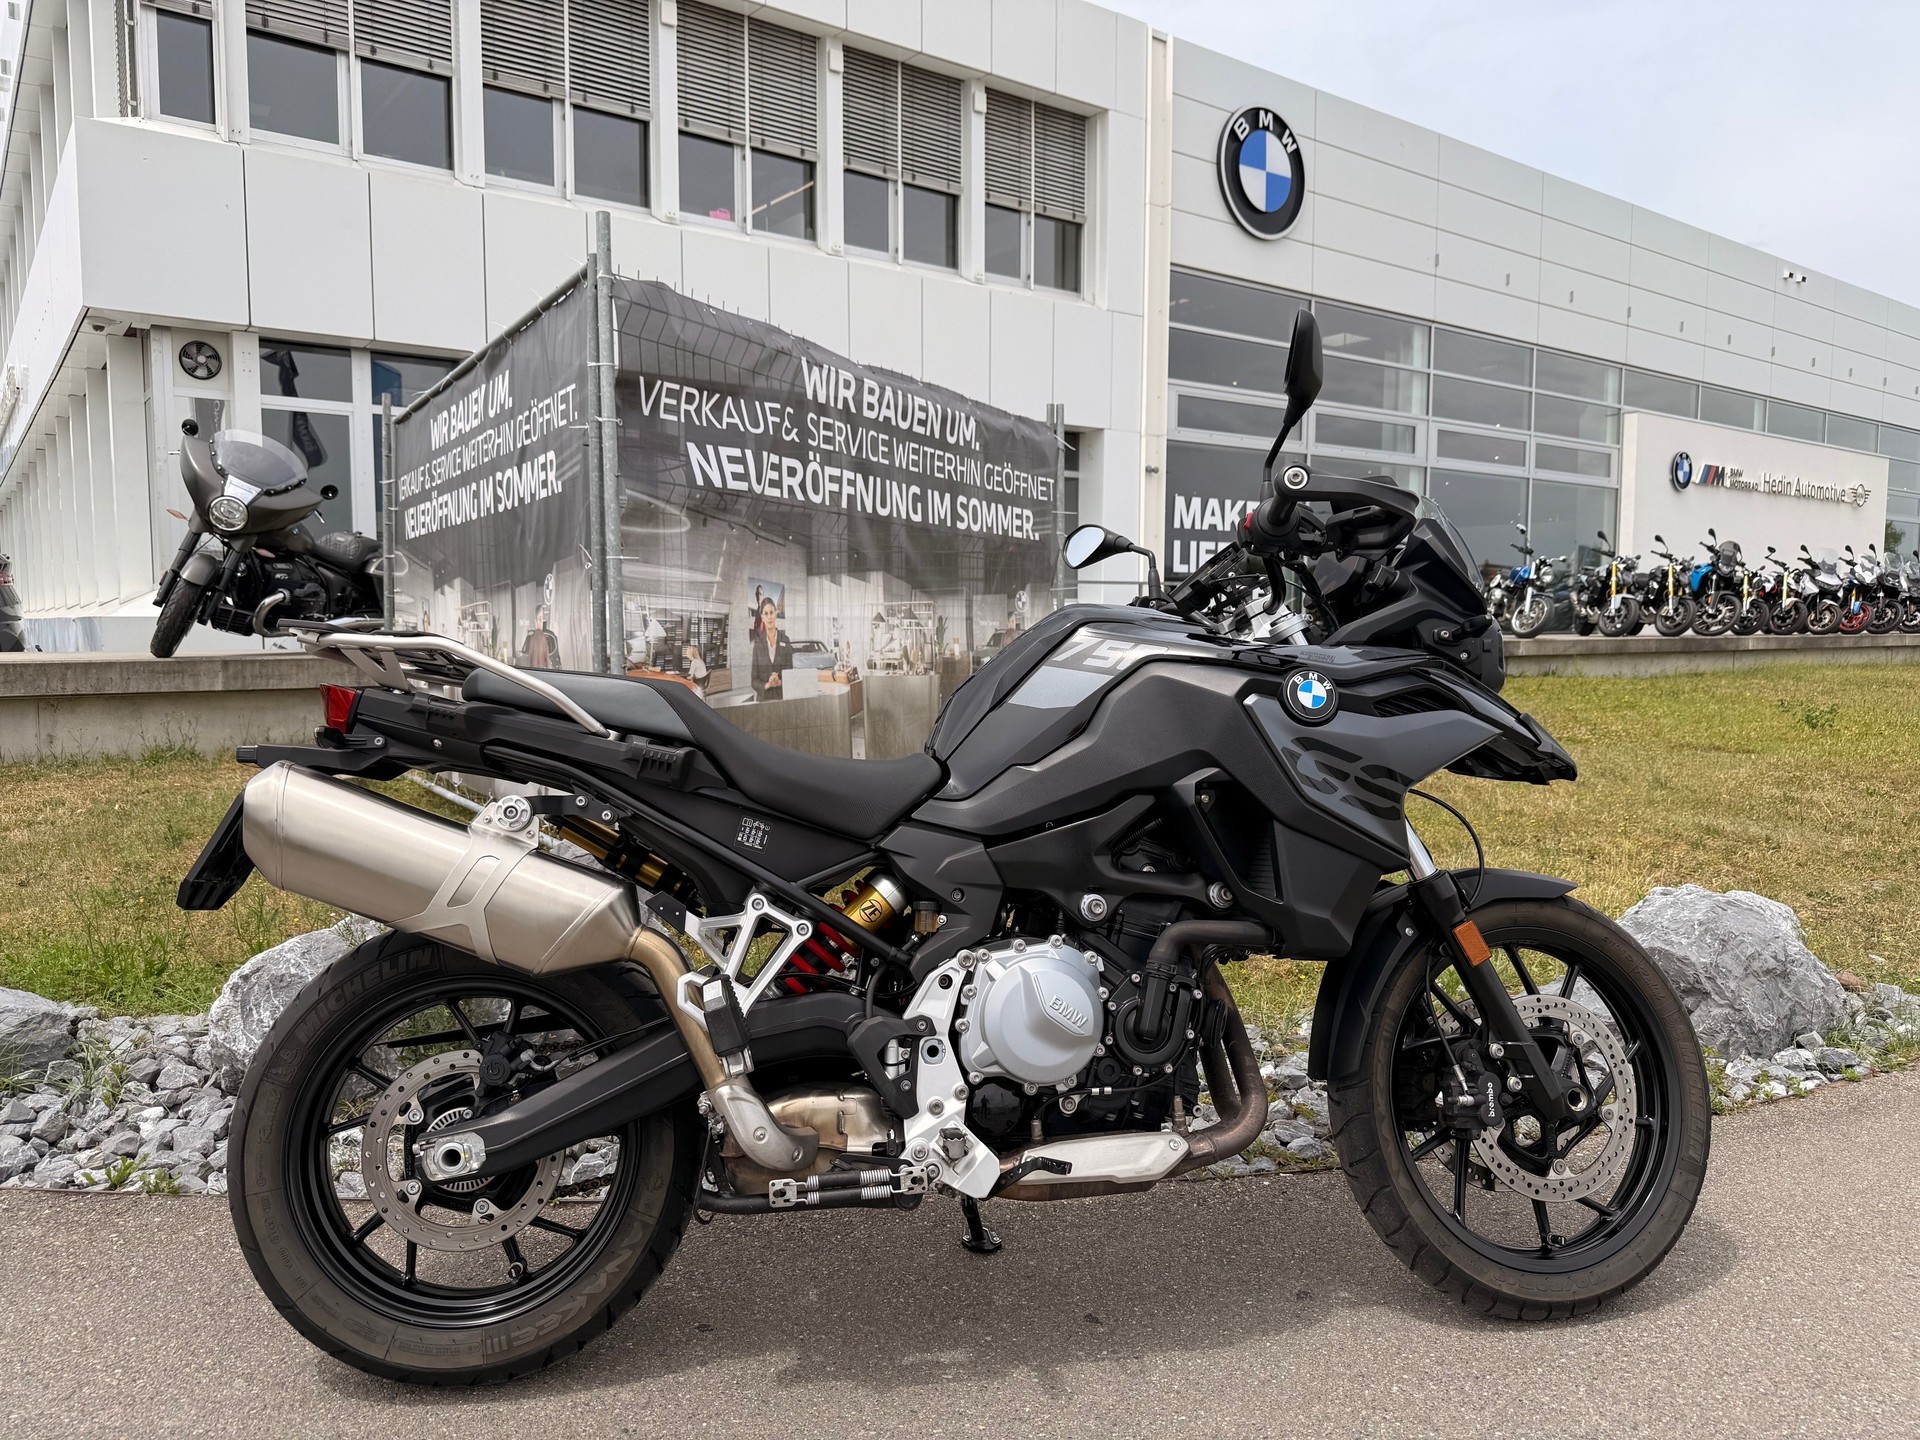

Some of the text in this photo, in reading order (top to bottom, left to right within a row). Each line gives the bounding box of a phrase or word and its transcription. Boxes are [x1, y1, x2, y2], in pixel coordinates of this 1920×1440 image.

[1233, 109, 1297, 154] BMW
[430, 410, 449, 451] WIR
[488, 369, 513, 419] UM.
[801, 356, 980, 451] WIR BAUEN UM.
[425, 463, 431, 490] &
[431, 446, 462, 487] SERVICE
[462, 420, 514, 473] WEITERHIN
[516, 383, 578, 449] GEÖFFNET.
[639, 375, 1055, 502] VERKAUF & SERVICE WEITERHIN GEÖFFNET
[404, 450, 563, 541] NEUERÖFFNUNG IM SOMMER.
[686, 441, 1040, 541] NEUERÖFFNUNG IM SOMMER.
[1730, 468, 1744, 478] BMW
[1763, 472, 1846, 502] Hedin Automotive
[1172, 540, 1232, 573] LIF
[1293, 672, 1333, 690] BMW
[861, 899, 882, 922] ZF
[295, 945, 436, 1045] MICHELIN
[1049, 994, 1089, 1029] BMW
[1486, 1081, 1495, 1118] brembo
